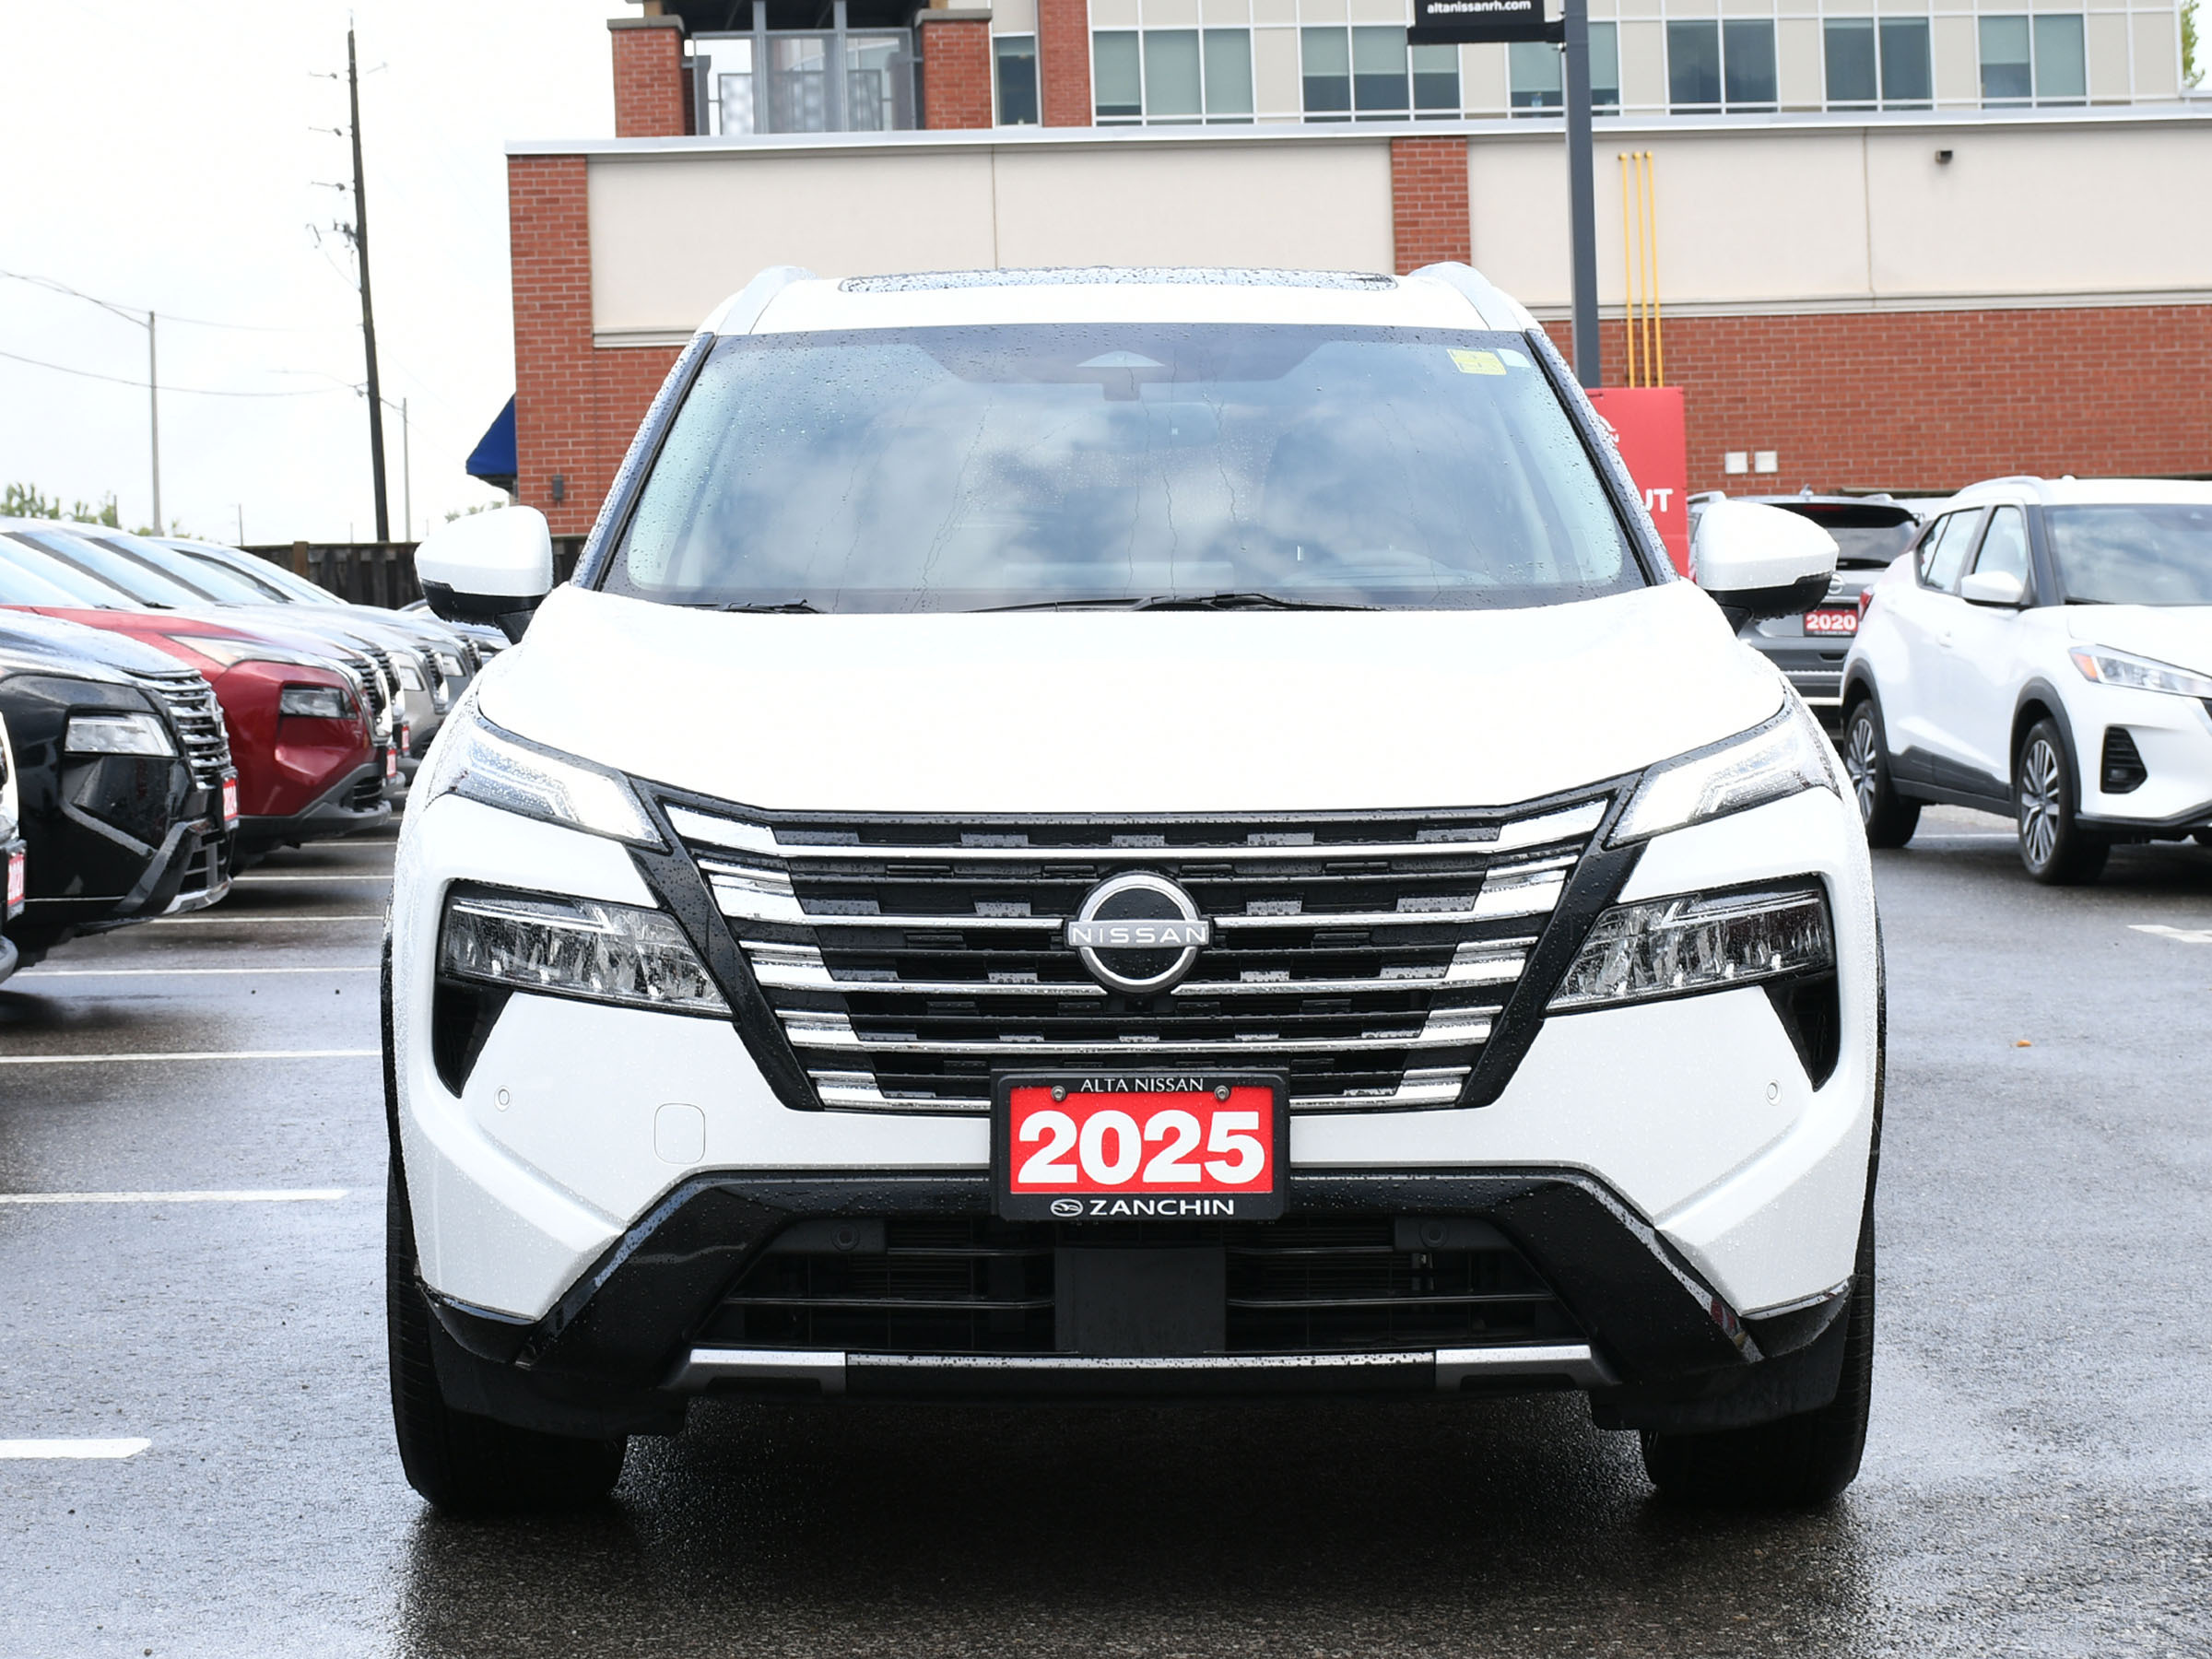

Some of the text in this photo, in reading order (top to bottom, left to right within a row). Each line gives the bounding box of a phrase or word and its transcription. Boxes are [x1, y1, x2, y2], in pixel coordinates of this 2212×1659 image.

[1427, 1, 1531, 14] altanissanrh.com
[1806, 614, 1856, 629] 2020
[1072, 927, 1206, 943] NISSAN
[1080, 1078, 1204, 1092] ALTA NISSAN
[1018, 1110, 1265, 1185] 2025
[1089, 1199, 1234, 1216] ZANCHIN
